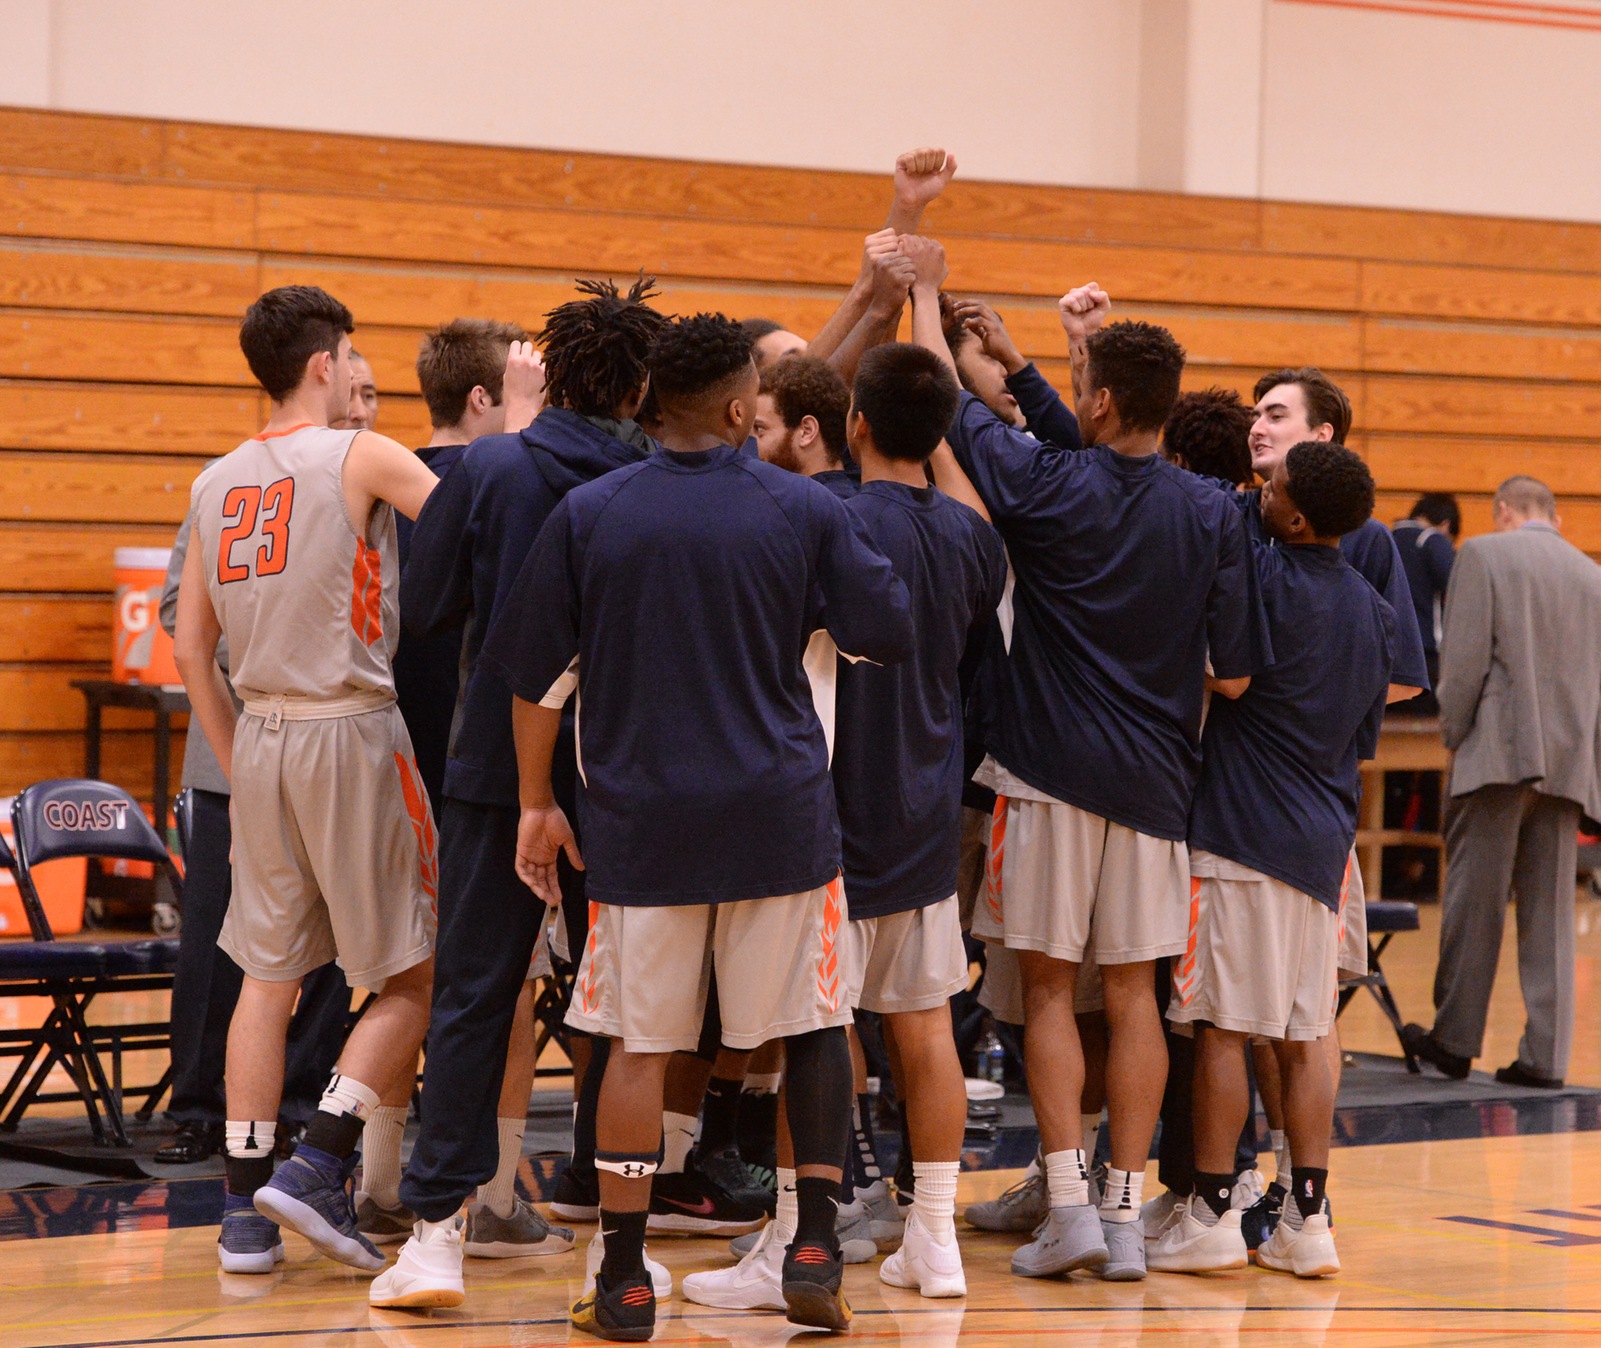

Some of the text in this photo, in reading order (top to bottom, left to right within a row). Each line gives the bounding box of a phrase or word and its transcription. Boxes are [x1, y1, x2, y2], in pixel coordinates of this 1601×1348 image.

[218, 476, 294, 584] 23
[121, 591, 149, 632] G
[44, 799, 130, 831] COAST
